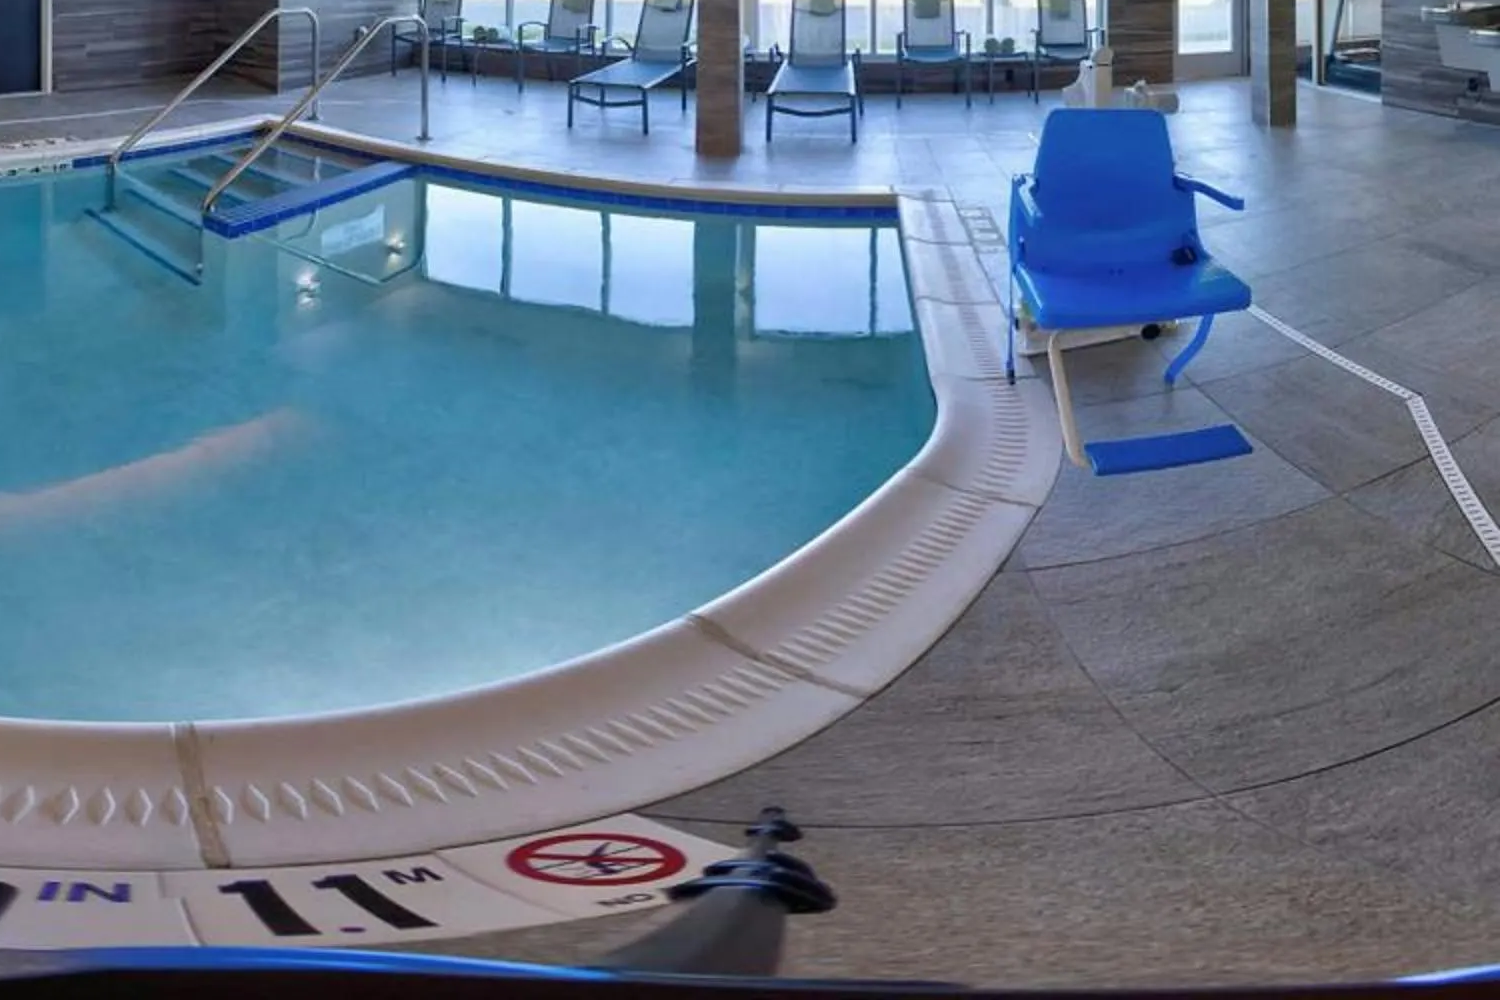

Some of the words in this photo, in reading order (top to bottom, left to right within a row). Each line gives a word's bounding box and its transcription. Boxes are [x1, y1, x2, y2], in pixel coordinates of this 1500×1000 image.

[36, 880, 132, 903] IN
[217, 873, 440, 937] 1.1
[381, 866, 443, 886] M
